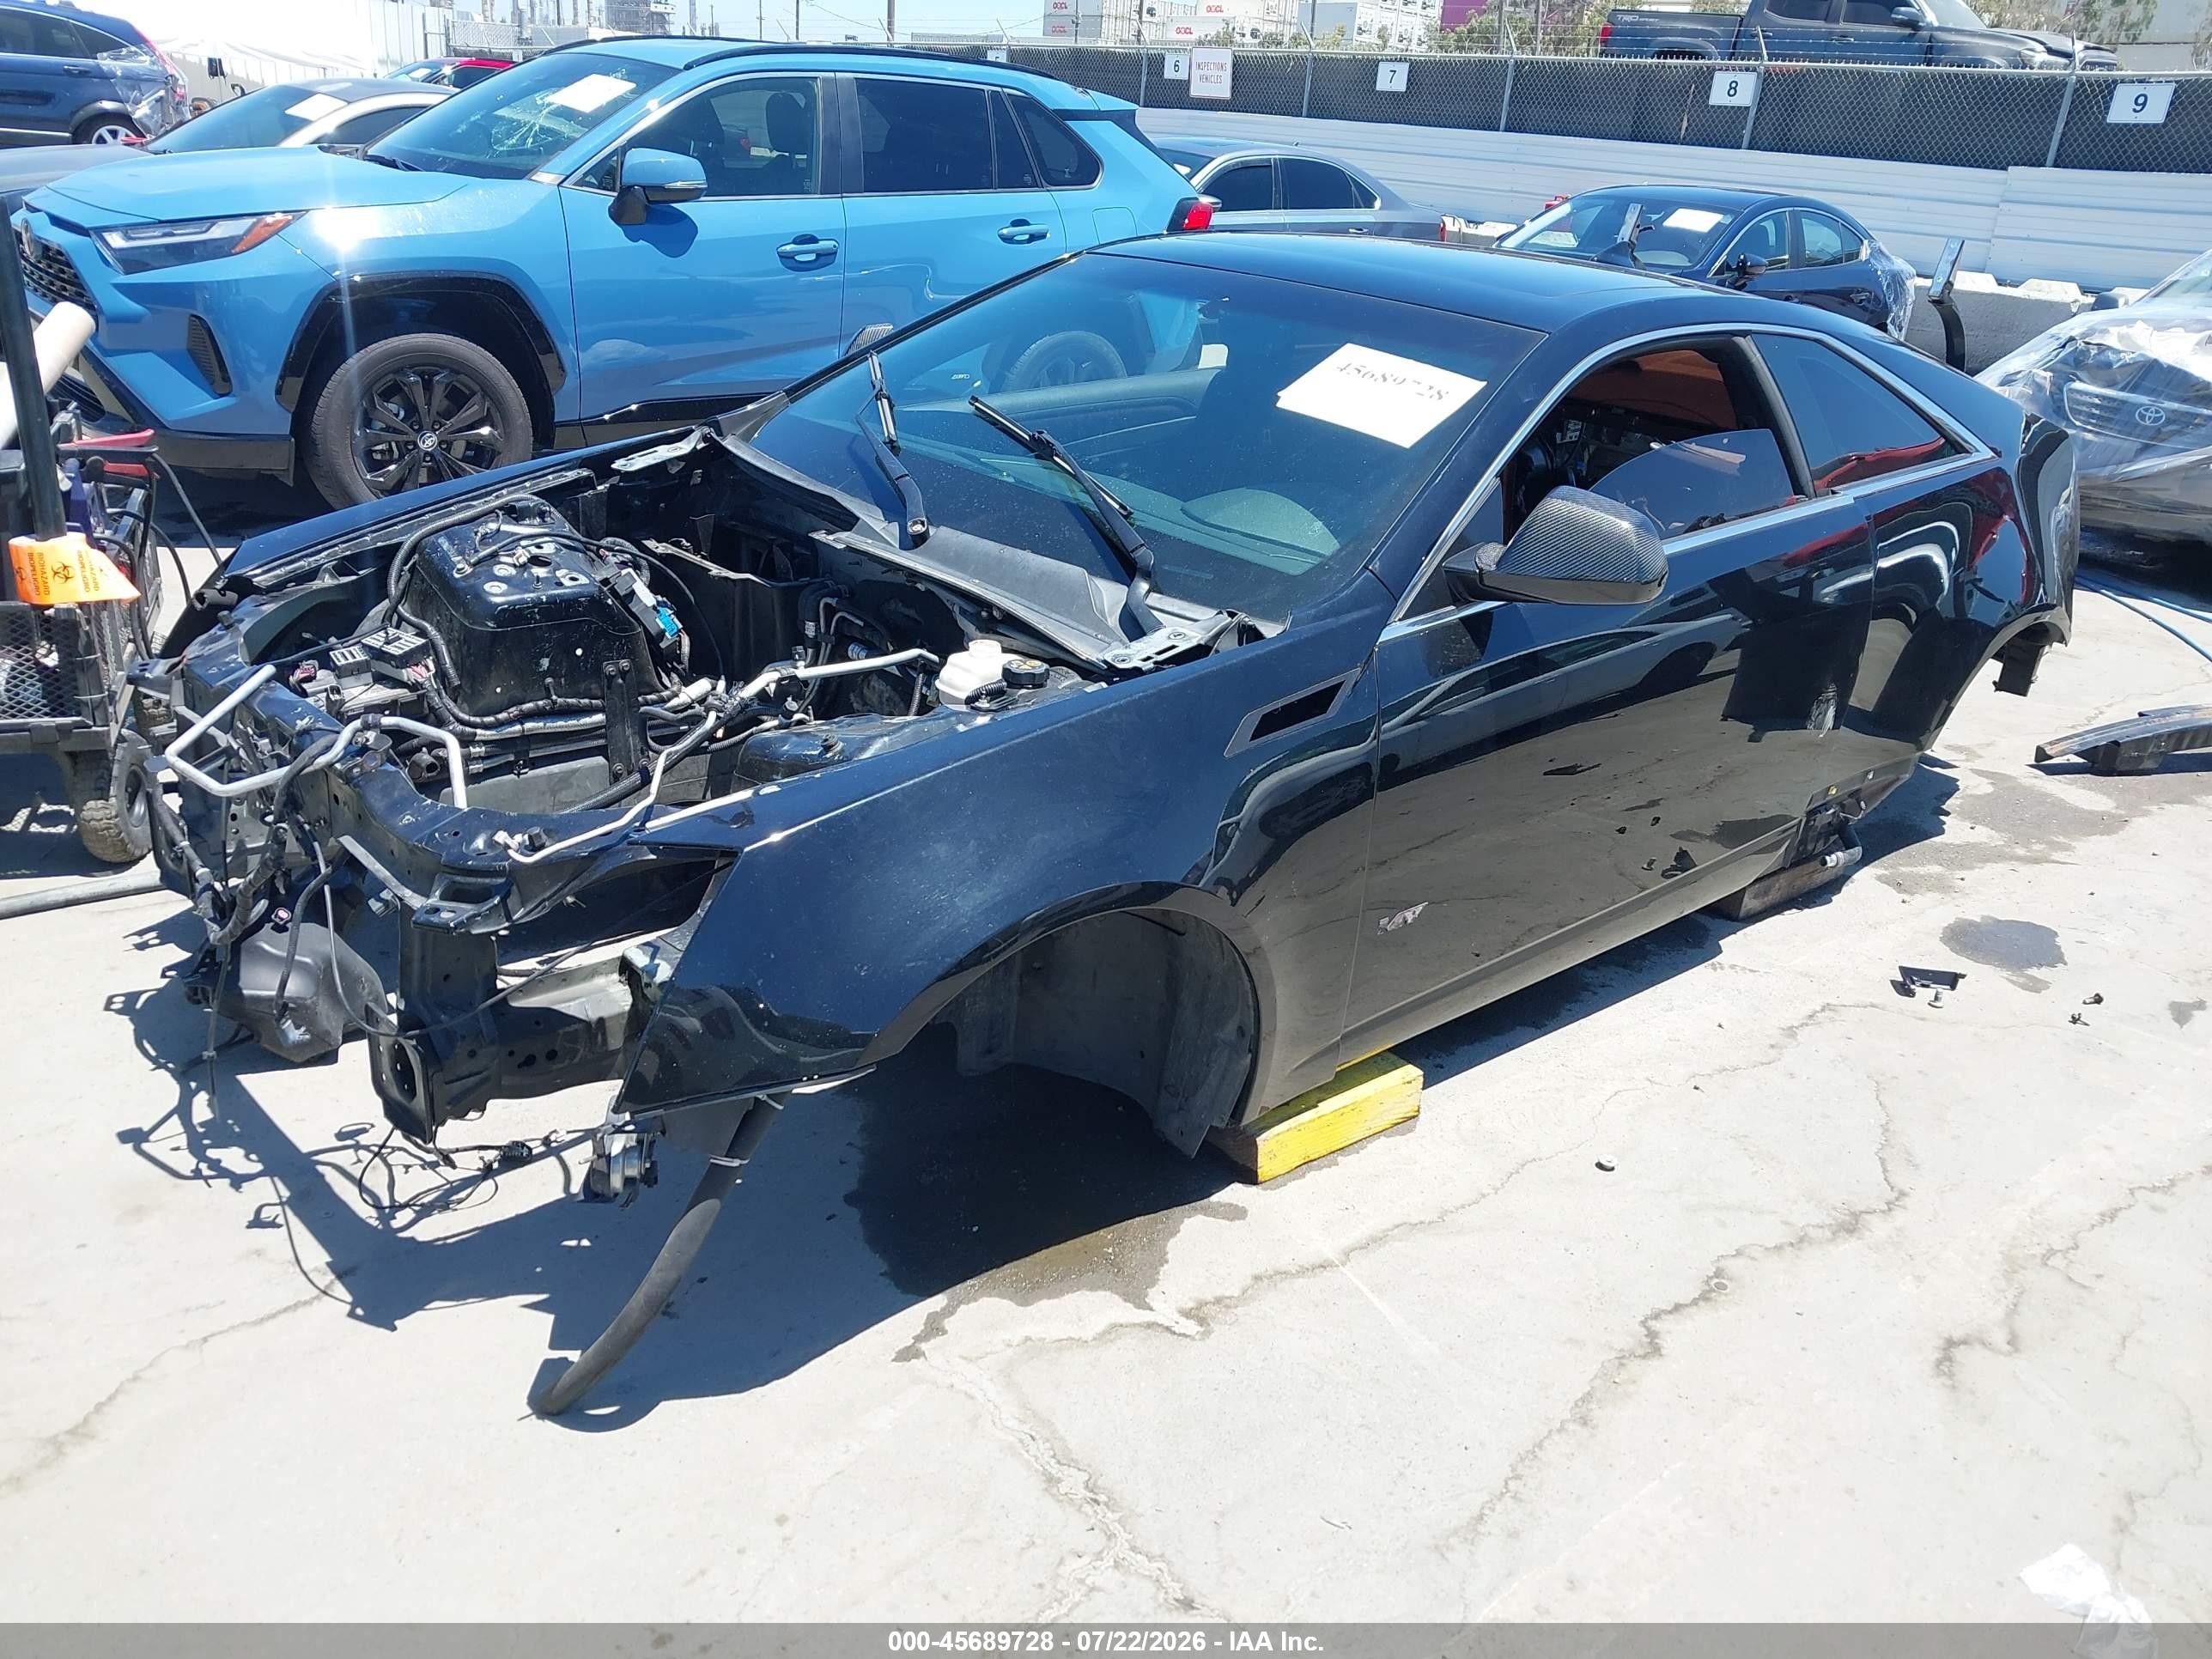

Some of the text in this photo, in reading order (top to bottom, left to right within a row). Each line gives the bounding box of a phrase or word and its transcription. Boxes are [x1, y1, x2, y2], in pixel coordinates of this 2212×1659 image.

[1616, 14, 1639, 22] TRD
[1173, 59, 1181, 73] 6
[1195, 61, 1227, 72] INSPECTIONS
[1199, 74, 1223, 84] VEHICLES
[1389, 69, 1397, 84] 7
[1727, 80, 1739, 97] 8
[2131, 94, 2148, 113] 9
